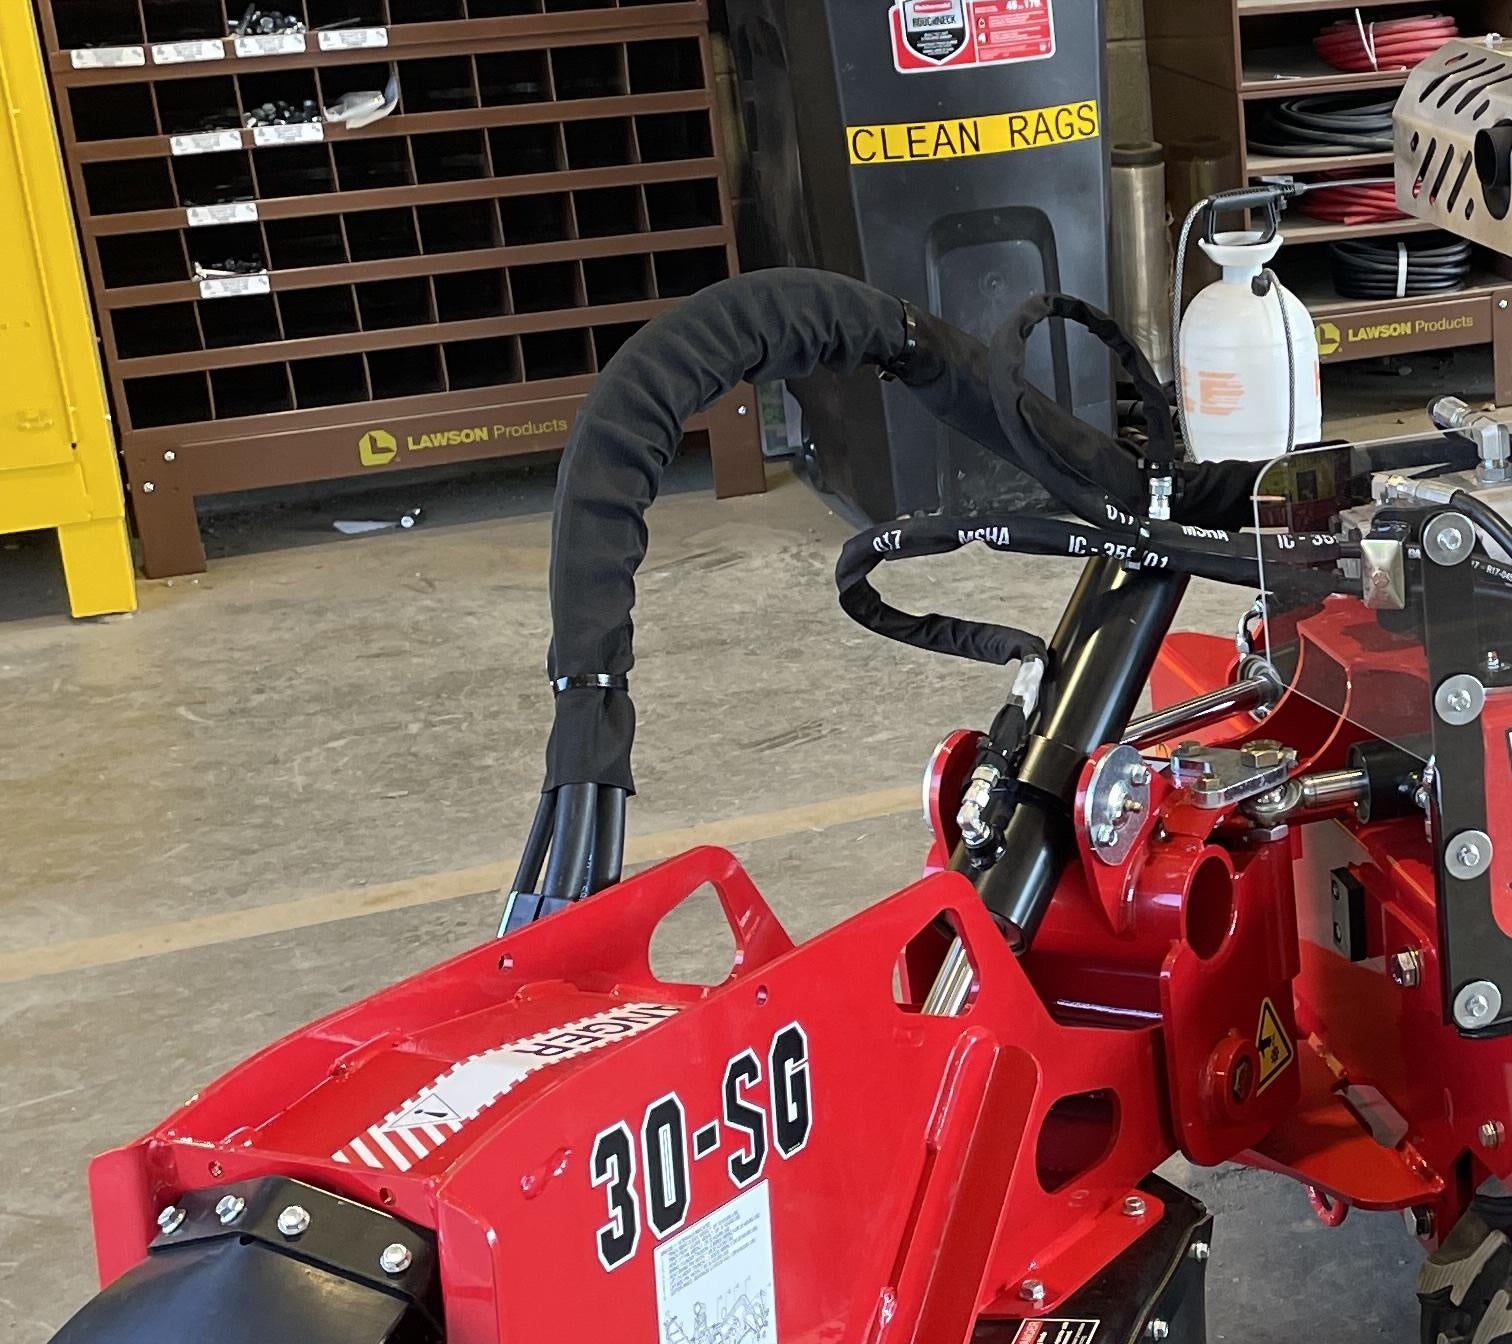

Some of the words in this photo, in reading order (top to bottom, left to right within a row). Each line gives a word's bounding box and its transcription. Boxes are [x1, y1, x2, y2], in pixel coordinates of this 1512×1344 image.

[852, 120, 981, 162] CLEAN
[1008, 103, 1096, 148] RAGS
[1348, 320, 1412, 342] LAWSON
[1415, 315, 1474, 333] Products
[407, 426, 489, 451] LAWSON
[494, 418, 568, 440] Products
[872, 529, 902, 553] 017
[957, 527, 1010, 546] MSHA
[1068, 535, 1087, 555] IC
[590, 1020, 813, 1273] 30-SG
